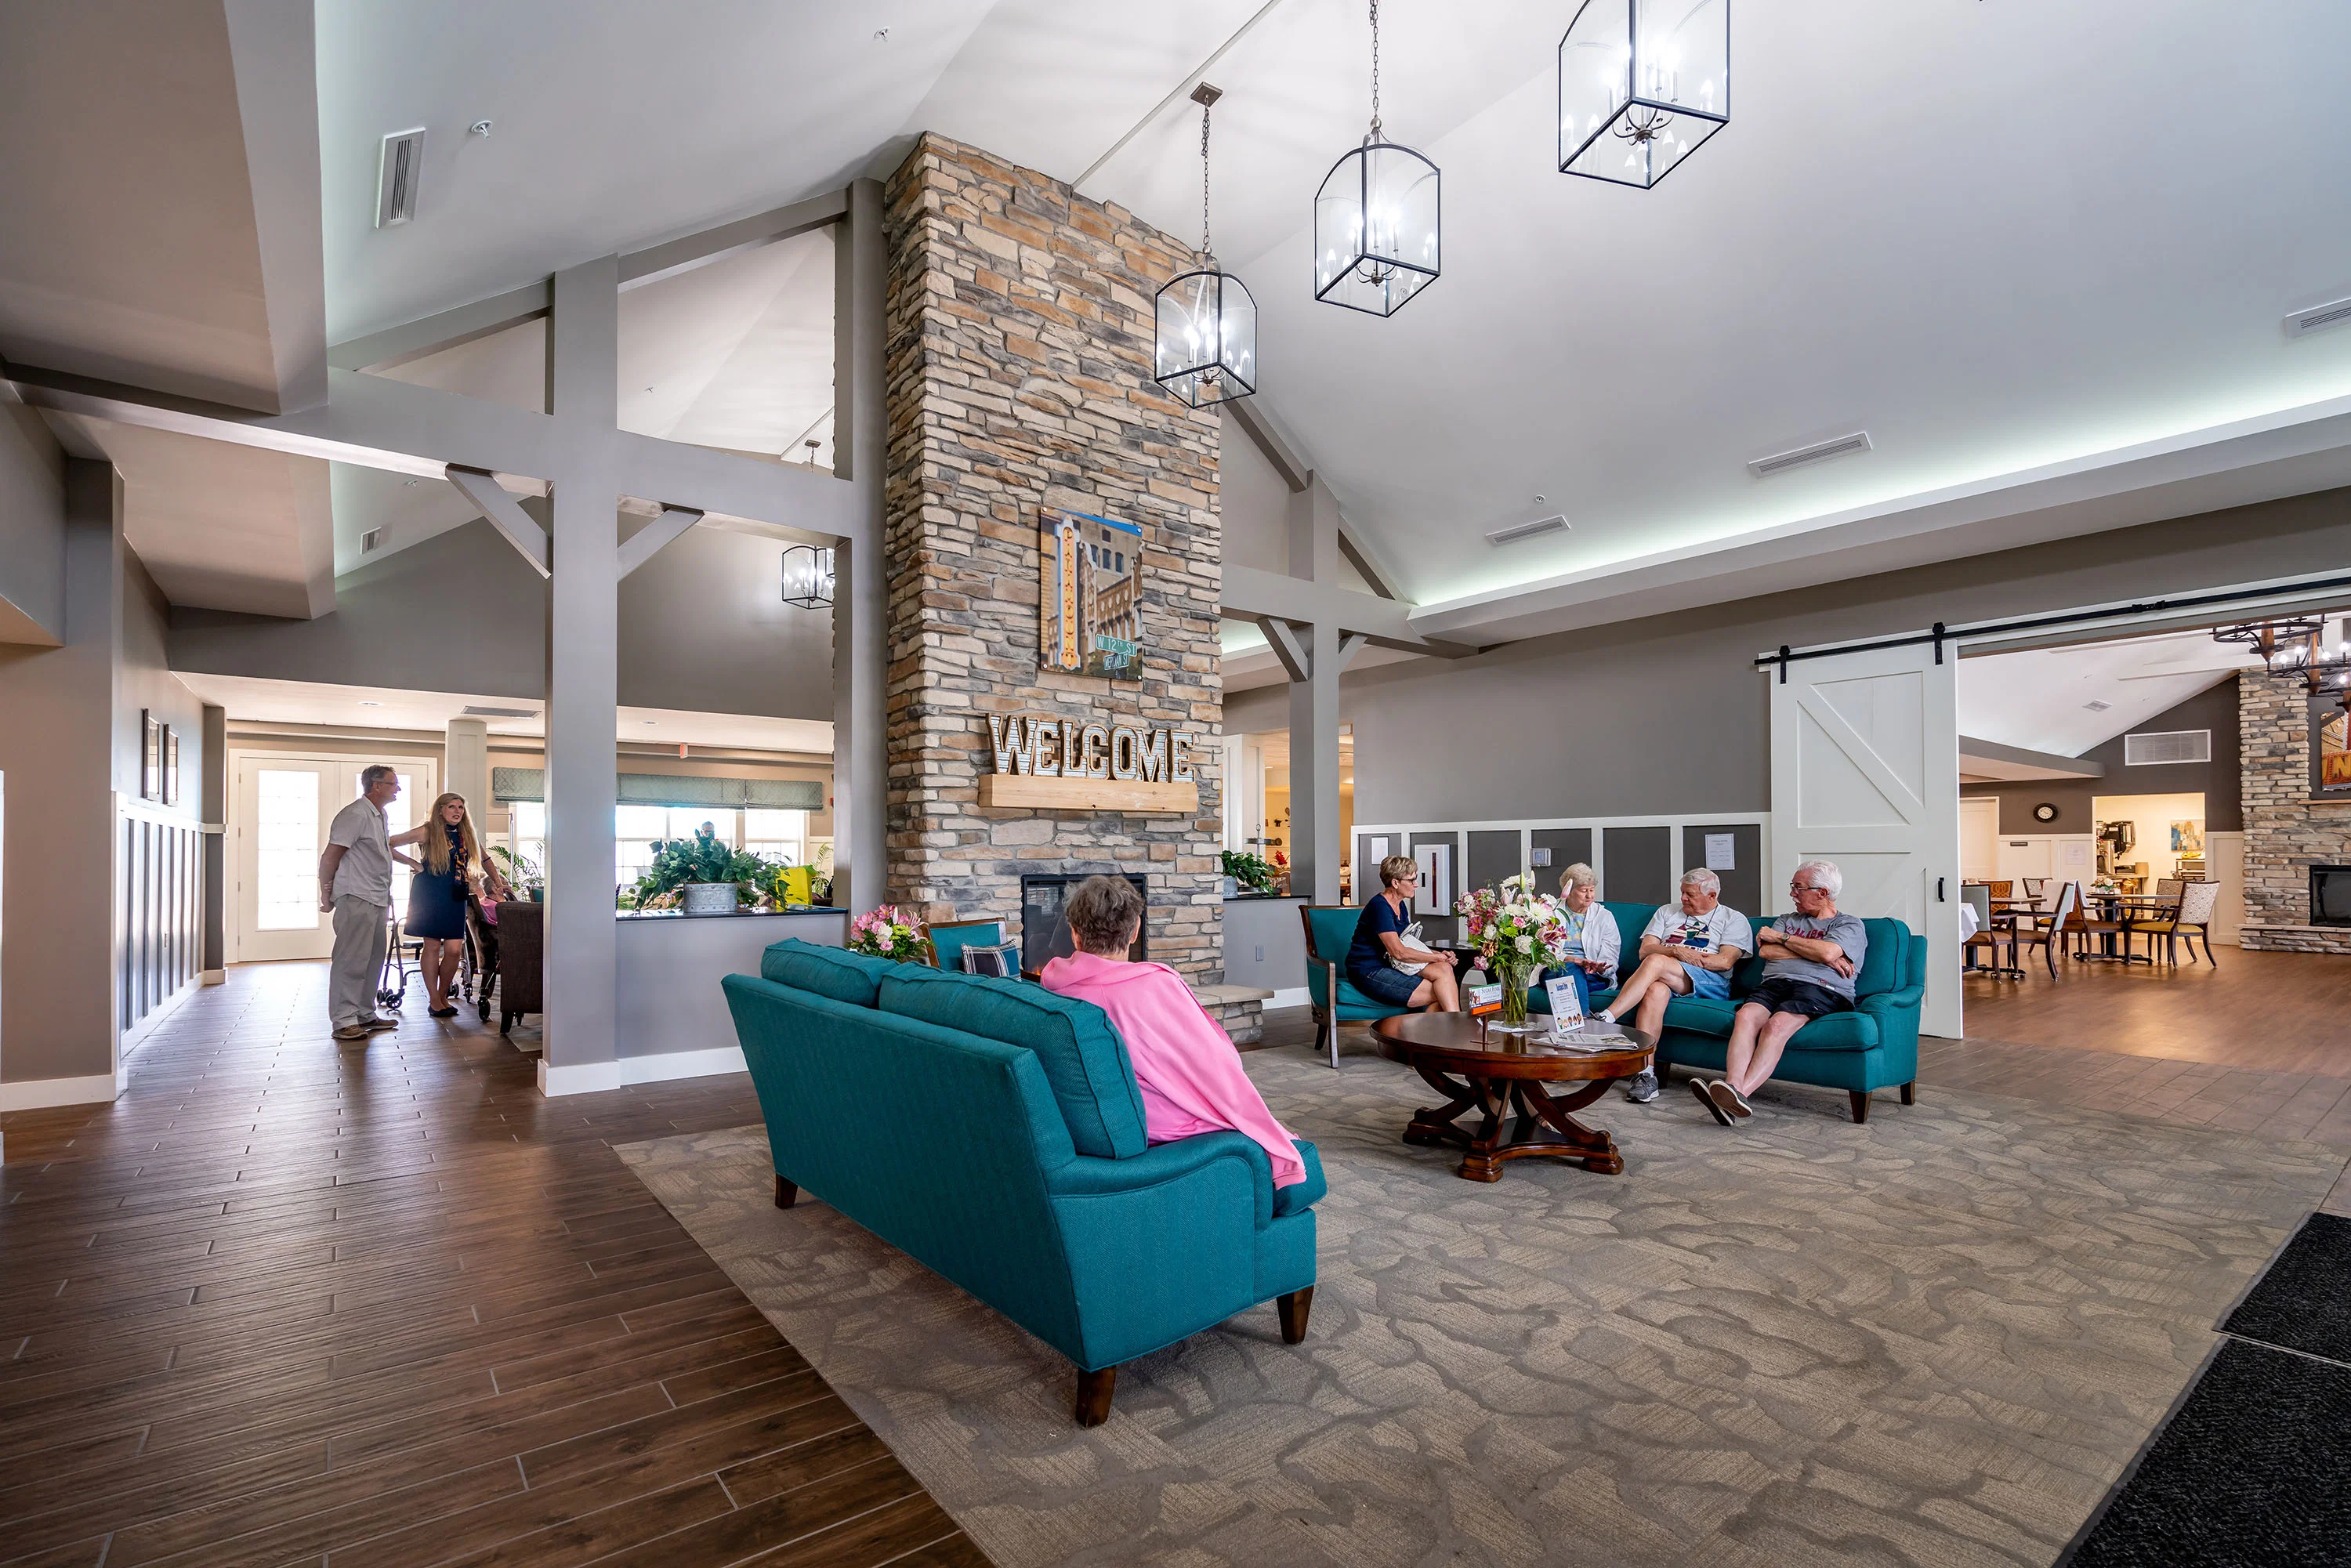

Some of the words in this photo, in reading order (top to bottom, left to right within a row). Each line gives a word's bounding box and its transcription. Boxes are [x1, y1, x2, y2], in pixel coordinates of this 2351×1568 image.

[1064, 528, 1074, 667] PARAMOUNT
[1097, 636, 1104, 648] W
[1107, 639, 1123, 651] 12TH
[1126, 643, 1136, 655] ST
[1123, 653, 1128, 665] ST
[986, 713, 1196, 784] WELCOME
